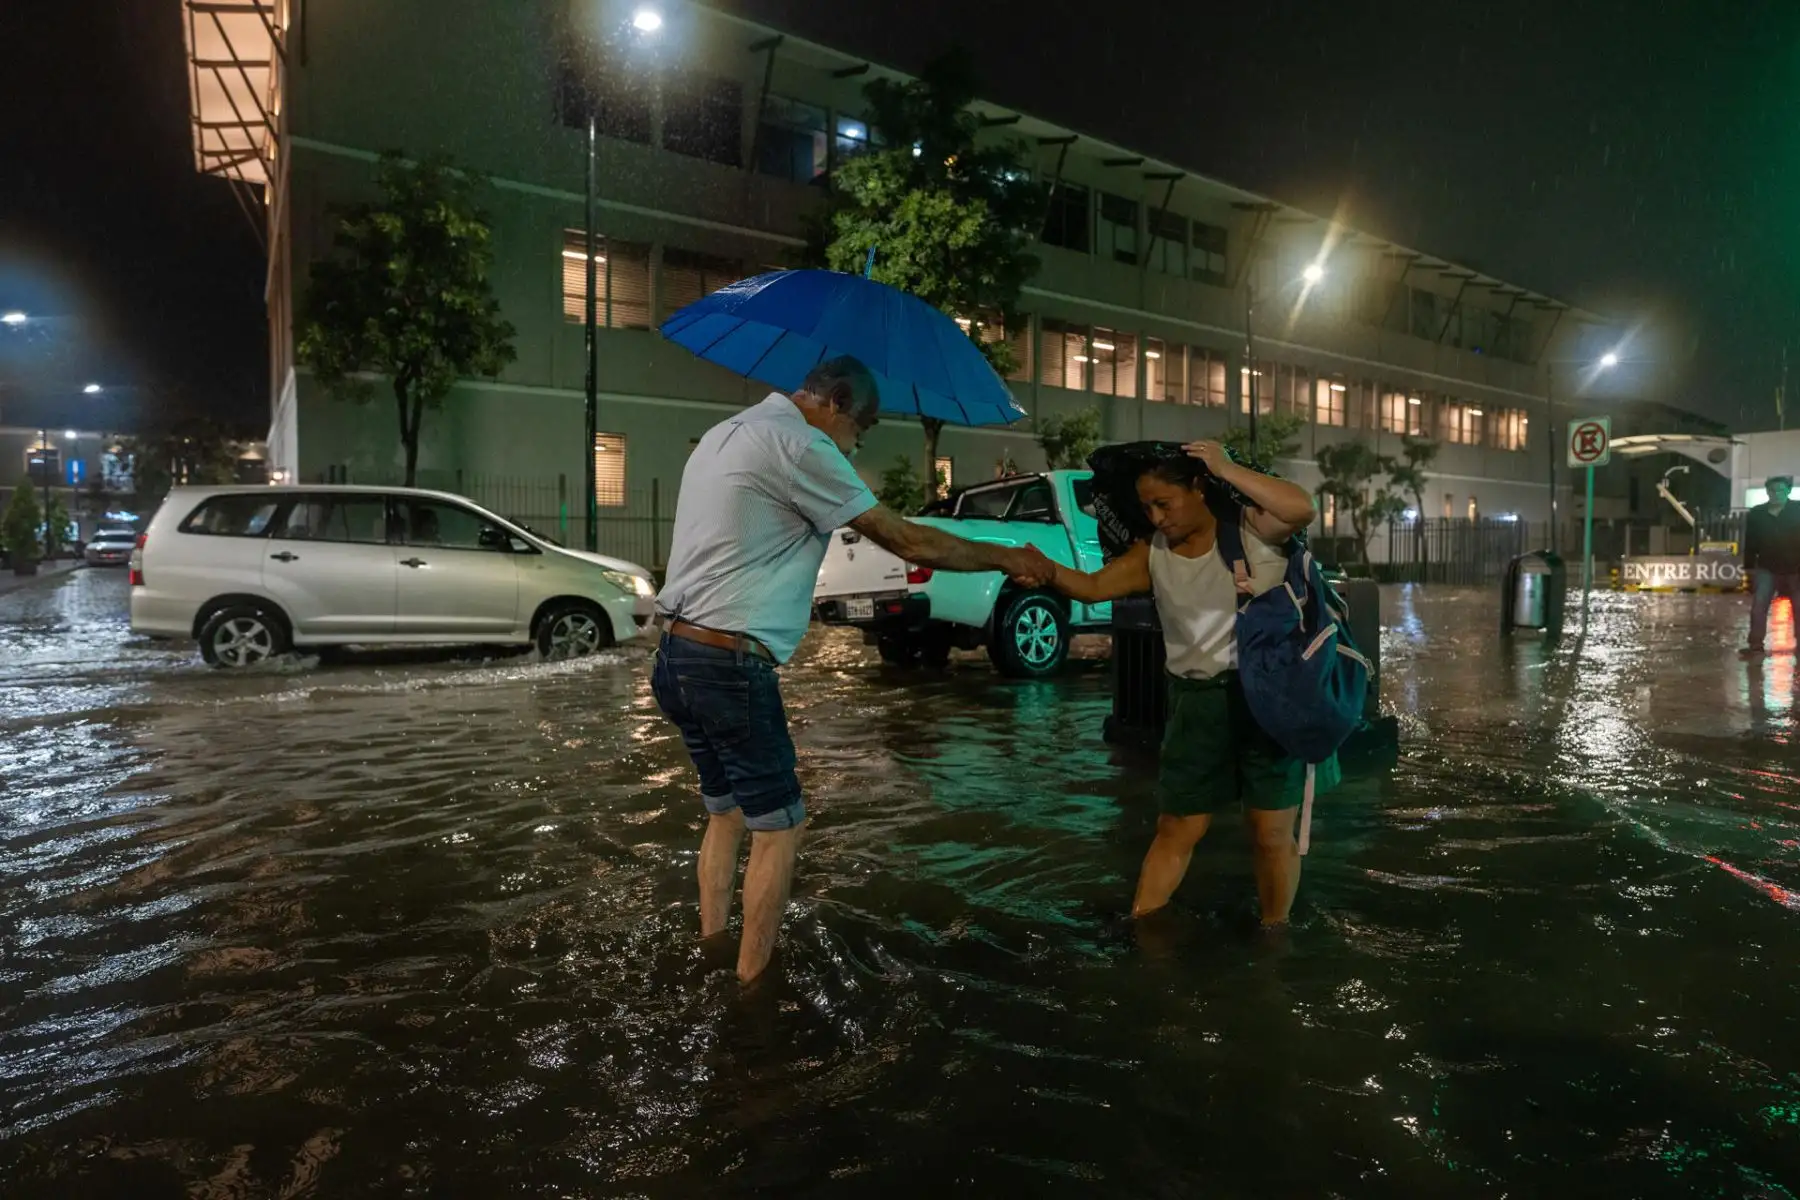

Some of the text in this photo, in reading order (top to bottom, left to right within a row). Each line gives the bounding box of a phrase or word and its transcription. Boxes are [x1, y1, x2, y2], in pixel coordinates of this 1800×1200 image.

[1580, 430, 1597, 454] E
[1623, 560, 1746, 580] ENTRE RÍOS
